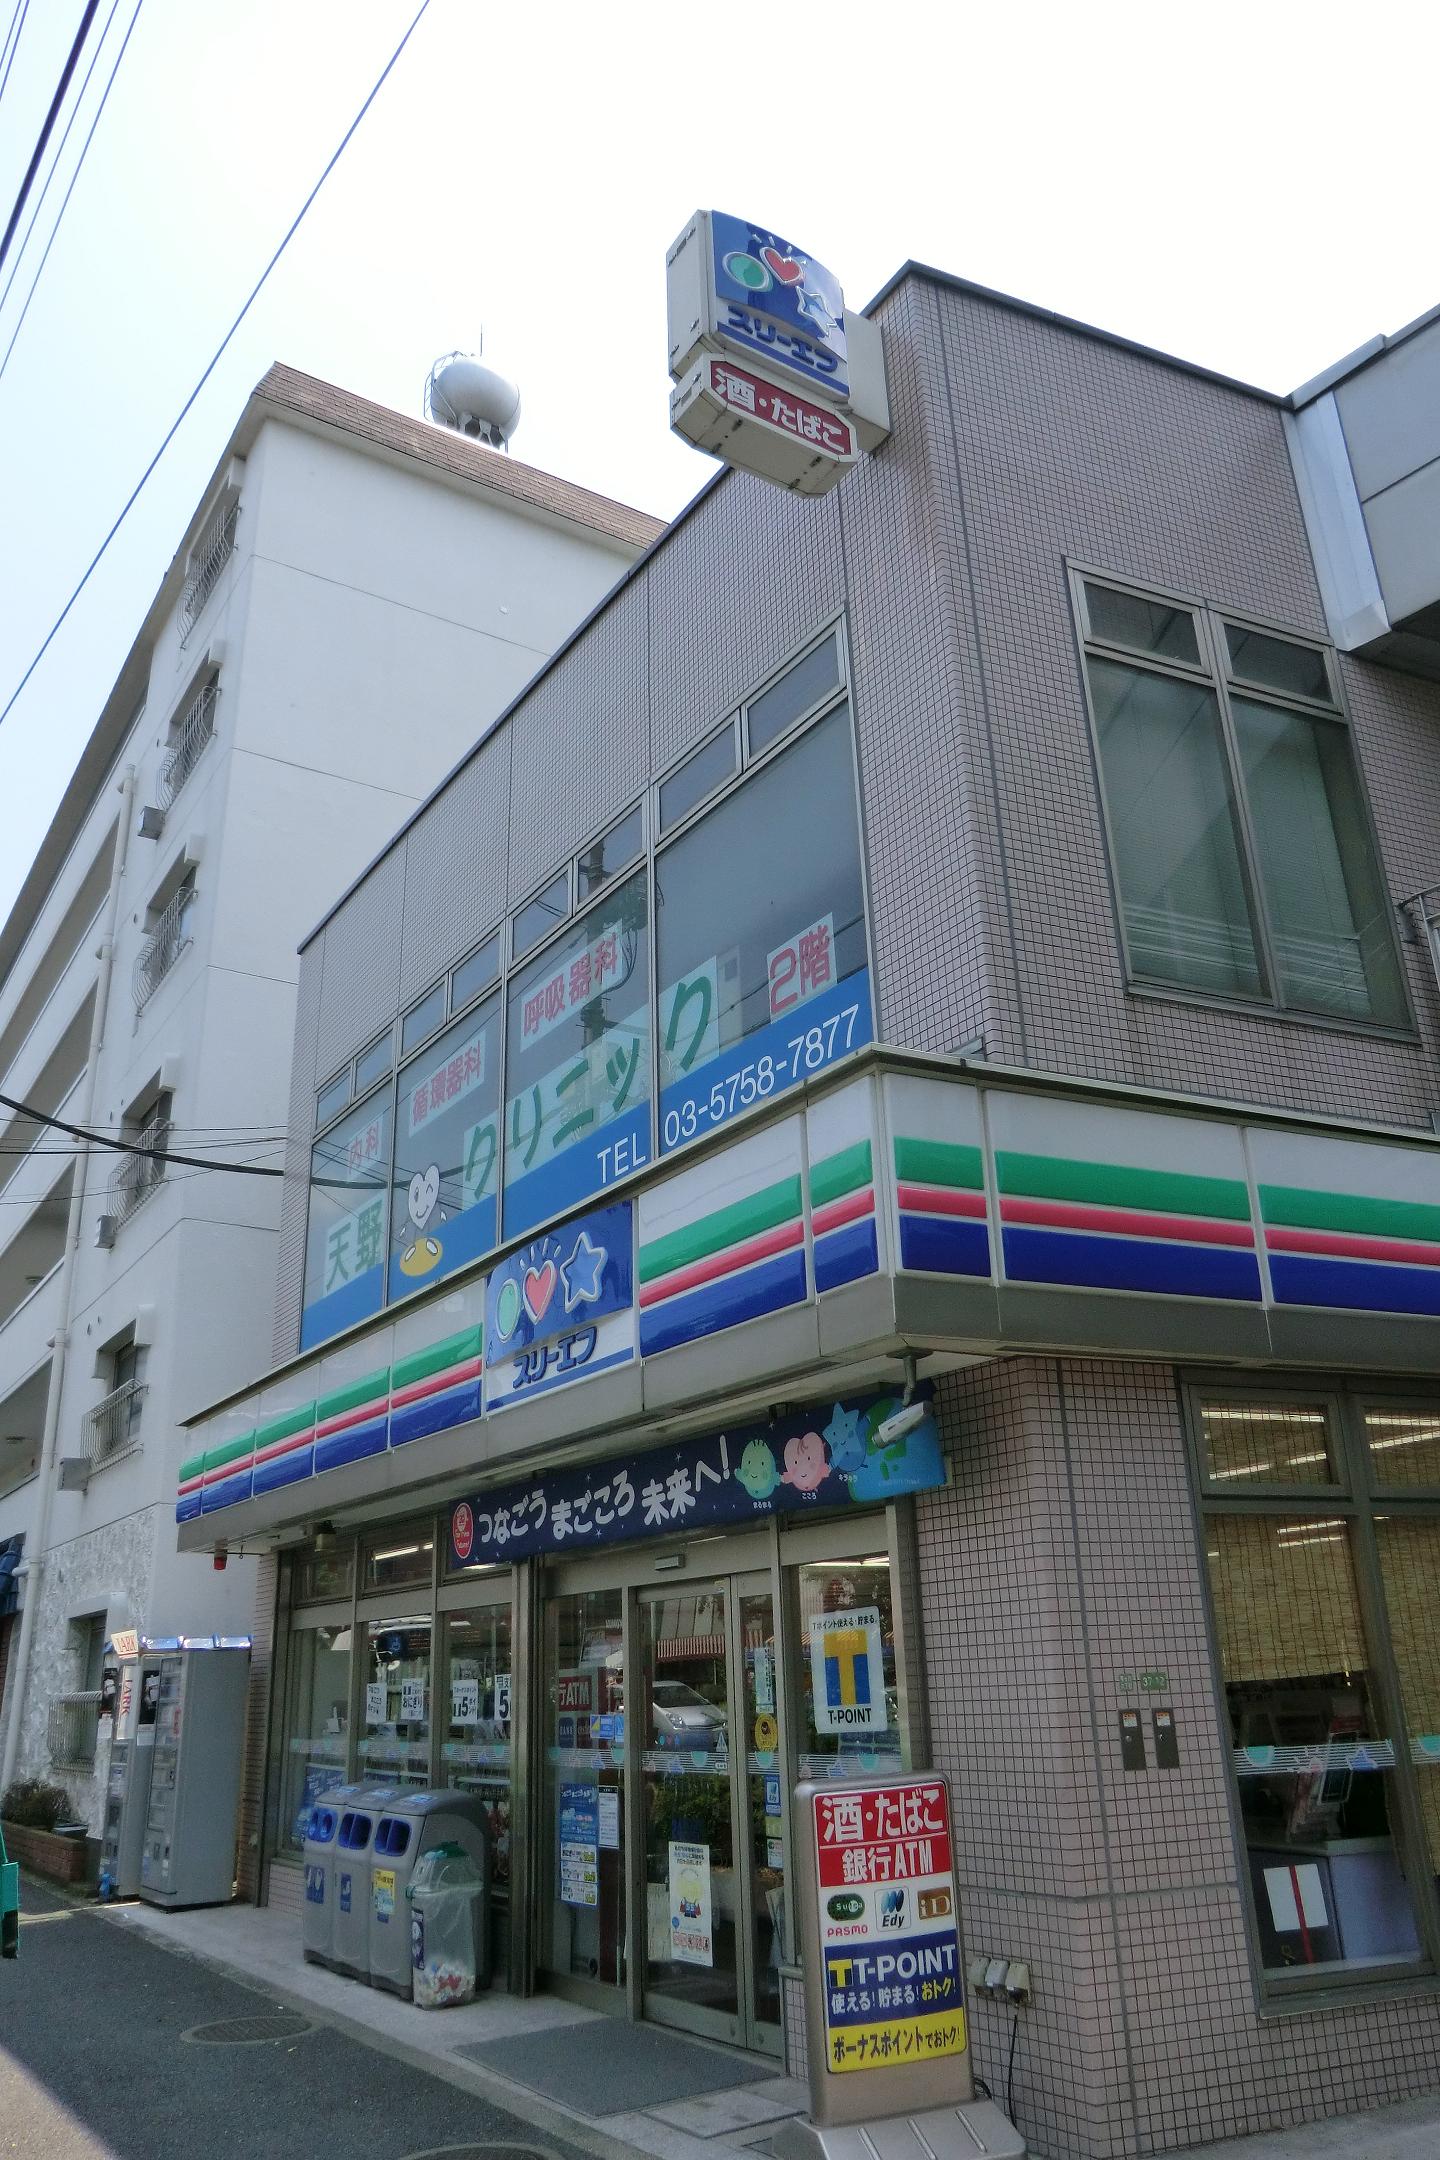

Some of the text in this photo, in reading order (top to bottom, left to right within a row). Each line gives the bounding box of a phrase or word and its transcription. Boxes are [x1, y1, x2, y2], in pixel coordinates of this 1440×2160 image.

[727, 304, 838, 373] スリーエフ
[714, 367, 846, 453] 酒・たばこ
[522, 931, 619, 1037] 呼吸器科
[769, 924, 832, 1015] 2階
[412, 1039, 482, 1127] 循環器科
[465, 976, 712, 1201] クリニック
[597, 1004, 860, 1184] TEL 03-5758-7877
[348, 1120, 380, 1174] 内科
[512, 1326, 598, 1389] スリーエフ
[479, 1434, 730, 1544] つなごう まごころ 未来へ!
[828, 1707, 872, 1724] T-POINT
[821, 1788, 943, 1843] 酒・たばこ
[841, 1839, 935, 1884] 銀行ATM
[827, 1924, 868, 1938] PASMO
[836, 1900, 863, 1913] Suica
[882, 1914, 905, 1929] Edy
[920, 1896, 951, 1918] iD
[852, 1943, 957, 1985] T-POINT
[833, 2025, 961, 2064] ボーナスポイントでおトク!
